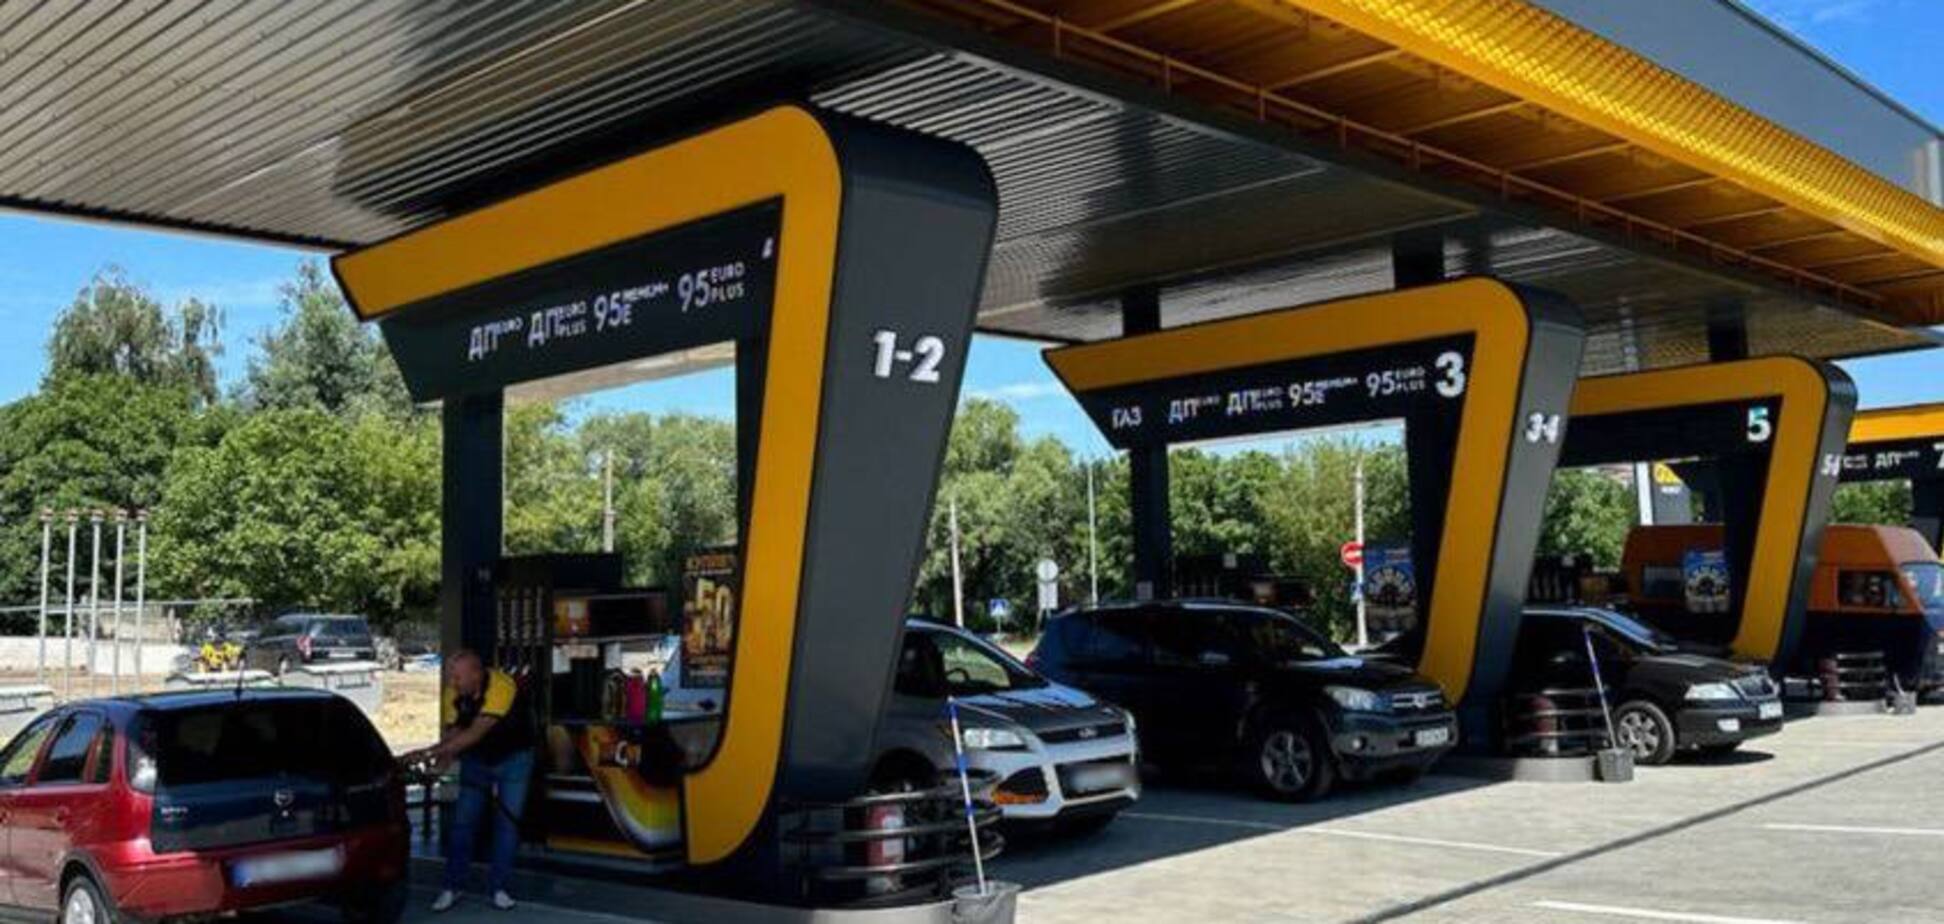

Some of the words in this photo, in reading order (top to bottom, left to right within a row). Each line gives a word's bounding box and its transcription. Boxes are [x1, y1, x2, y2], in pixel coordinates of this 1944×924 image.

[677, 271, 710, 312] 95
[710, 261, 745, 284] EURO
[710, 282, 745, 303] PLUS
[594, 292, 621, 331] 95
[873, 329, 946, 383] 1-2
[1366, 371, 1395, 397] 95
[1435, 351, 1466, 398] 3
[1288, 382, 1314, 407] 95
[1112, 406, 1143, 429] ГАЗ
[1746, 406, 1771, 442] 5
